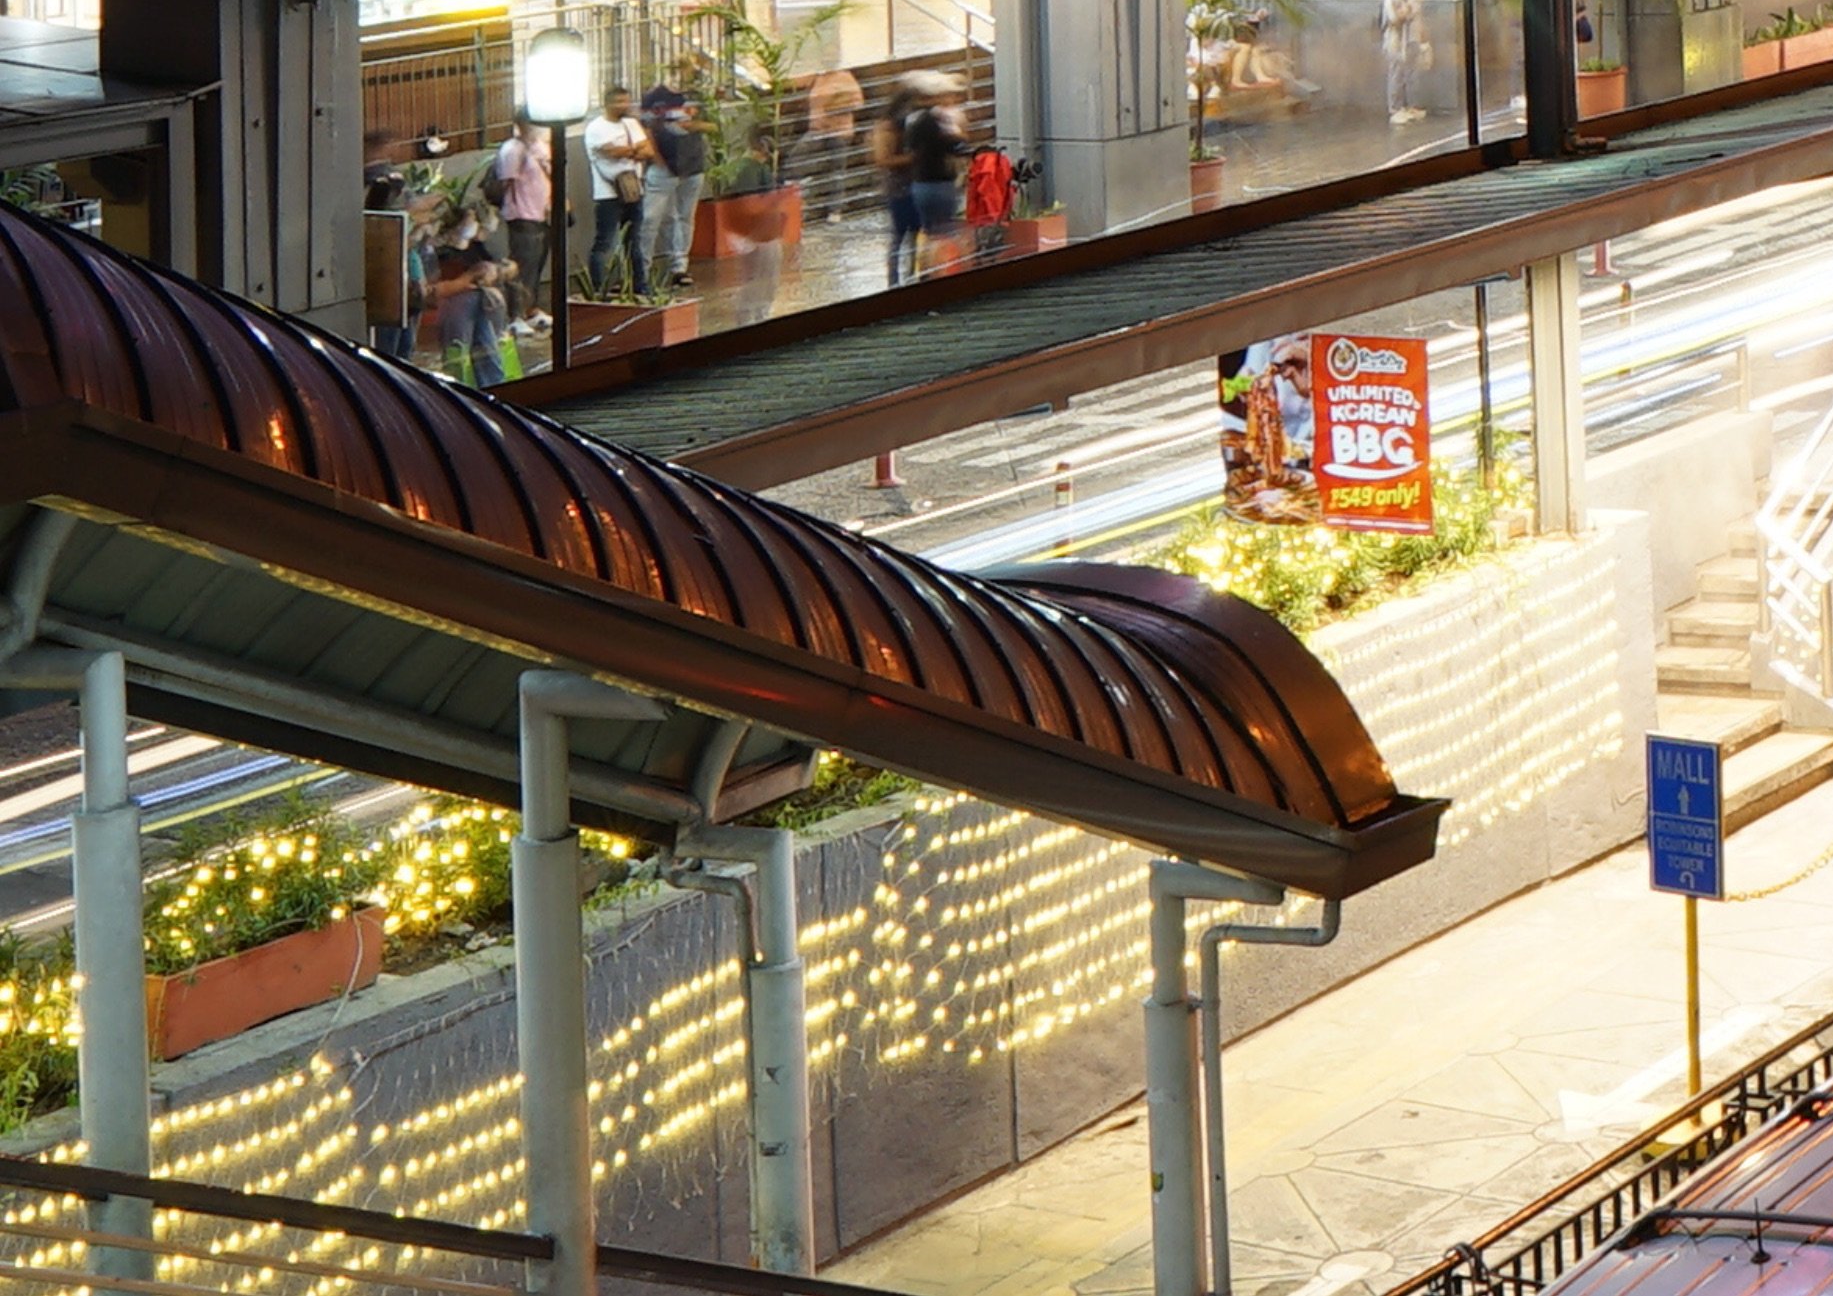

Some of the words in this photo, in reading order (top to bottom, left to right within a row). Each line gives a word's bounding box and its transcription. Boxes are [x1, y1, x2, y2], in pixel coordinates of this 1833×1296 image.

[1327, 384, 1415, 407] UNLIMITED
[1331, 403, 1416, 427] KOREAN
[1375, 480, 1421, 510] only!
[1657, 749, 1710, 785] MALL
